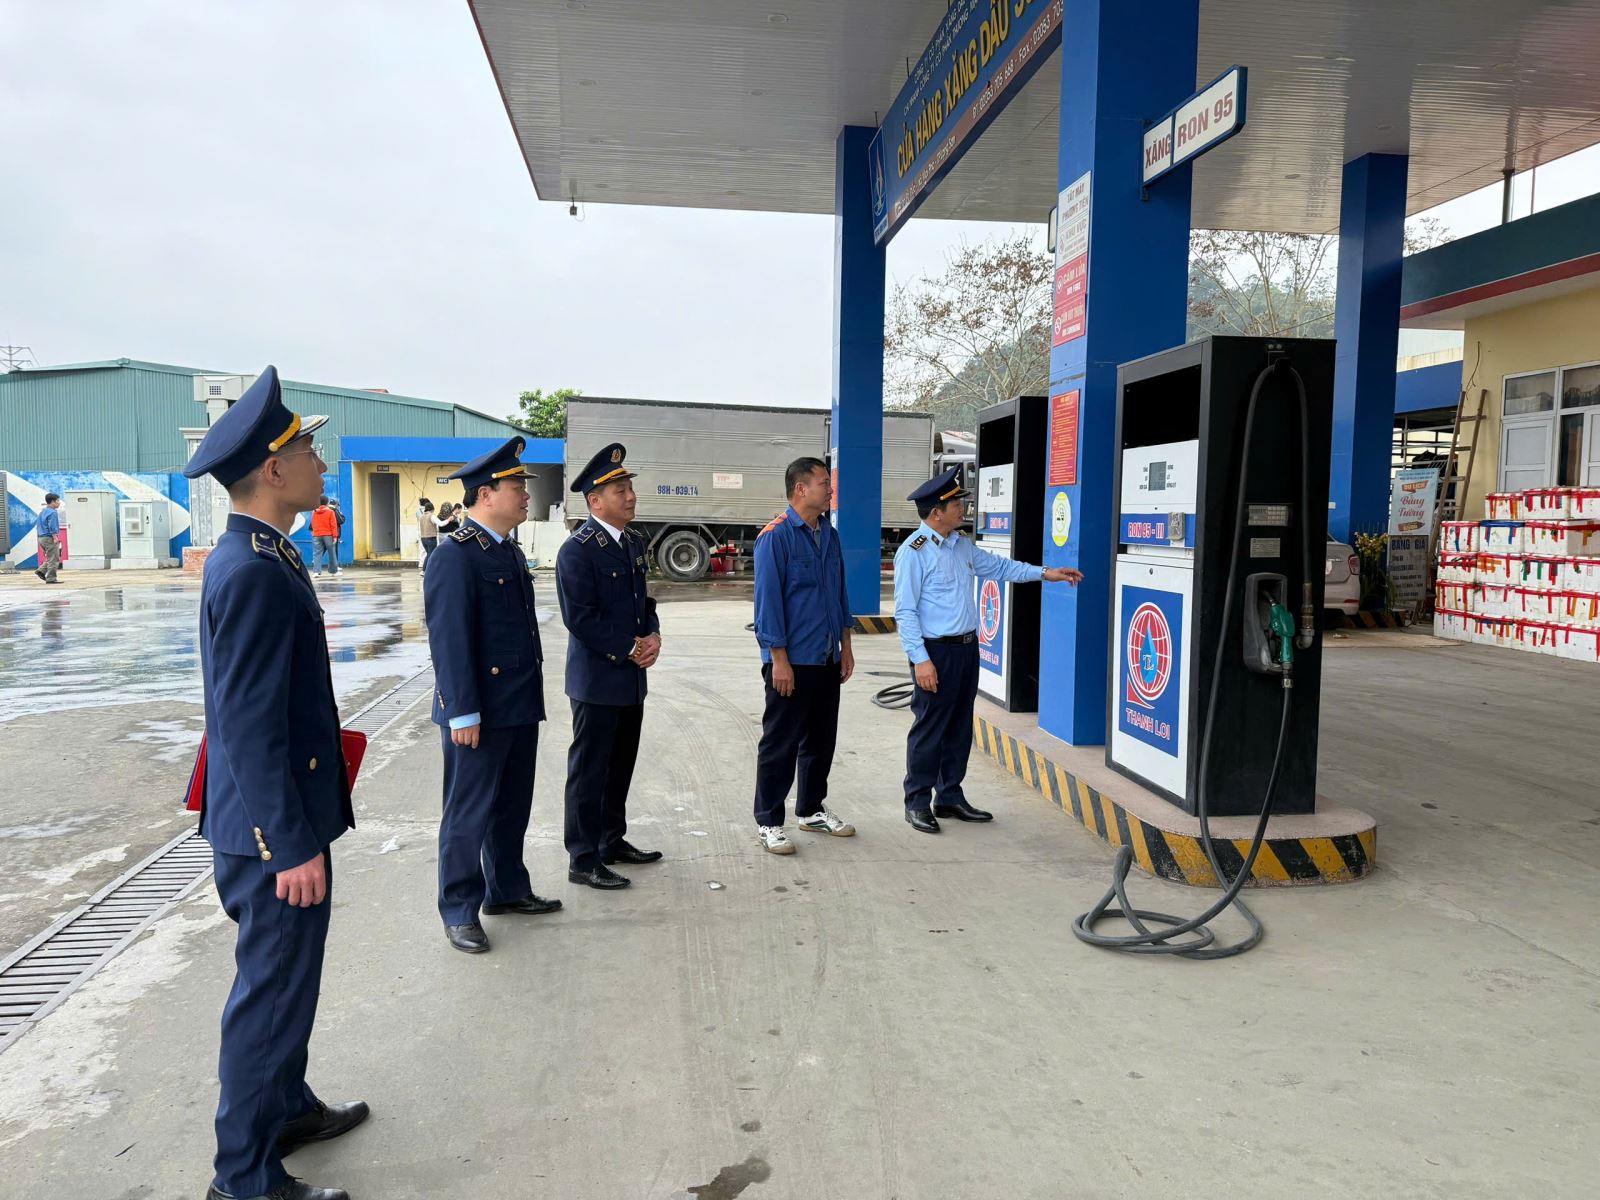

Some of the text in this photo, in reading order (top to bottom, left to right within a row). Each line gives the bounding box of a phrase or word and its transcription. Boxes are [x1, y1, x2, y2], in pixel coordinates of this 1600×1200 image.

[898, 122, 915, 178] CỬA
[915, 89, 944, 155] HÀNG
[944, 38, 977, 117] XĂNG
[1145, 91, 1233, 169] XĂNG RON 95
[1128, 522, 1142, 538] RON
[1143, 521, 1152, 538] 95
[1125, 707, 1153, 734] THANH
